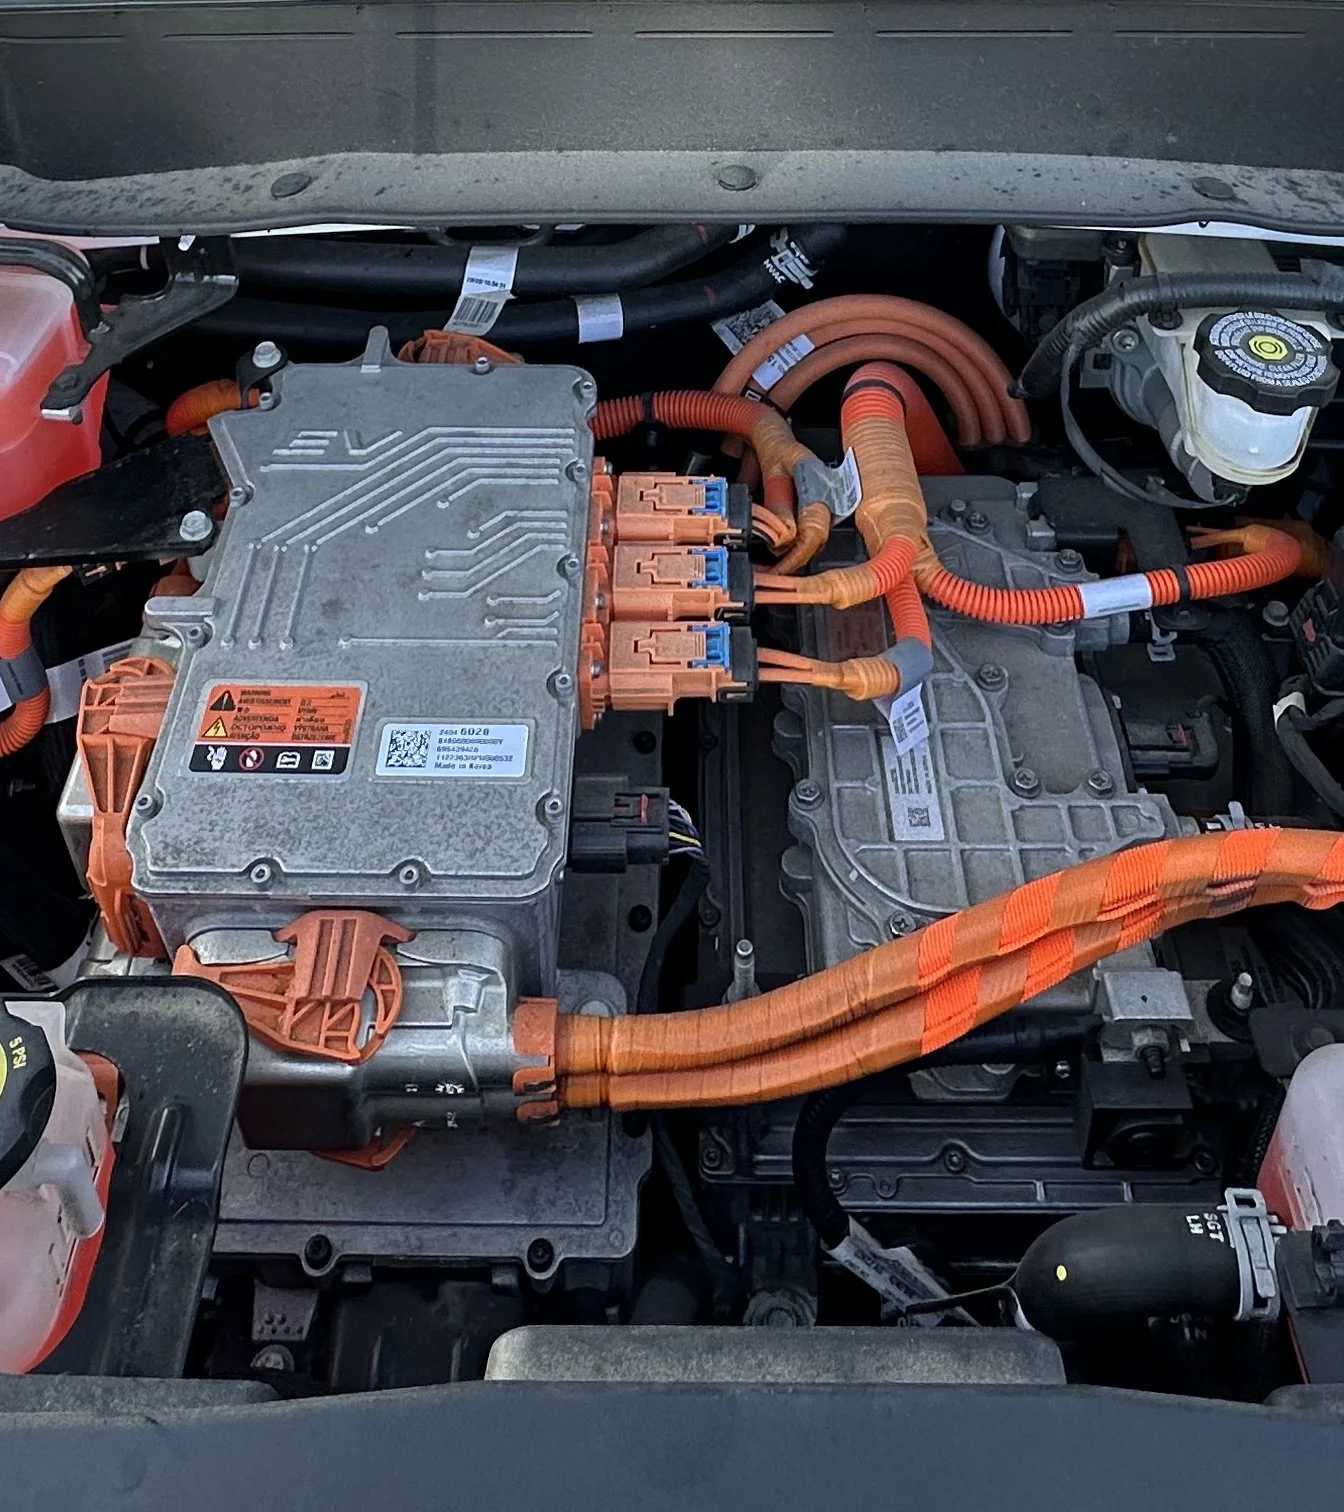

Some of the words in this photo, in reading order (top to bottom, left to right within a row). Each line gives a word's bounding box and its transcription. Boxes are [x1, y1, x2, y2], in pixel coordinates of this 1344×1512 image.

[9, 1036, 22, 1048] 5
[12, 1046, 27, 1069] PSI
[1185, 1214, 1204, 1234] LH
[1204, 1212, 1225, 1243] SGT
